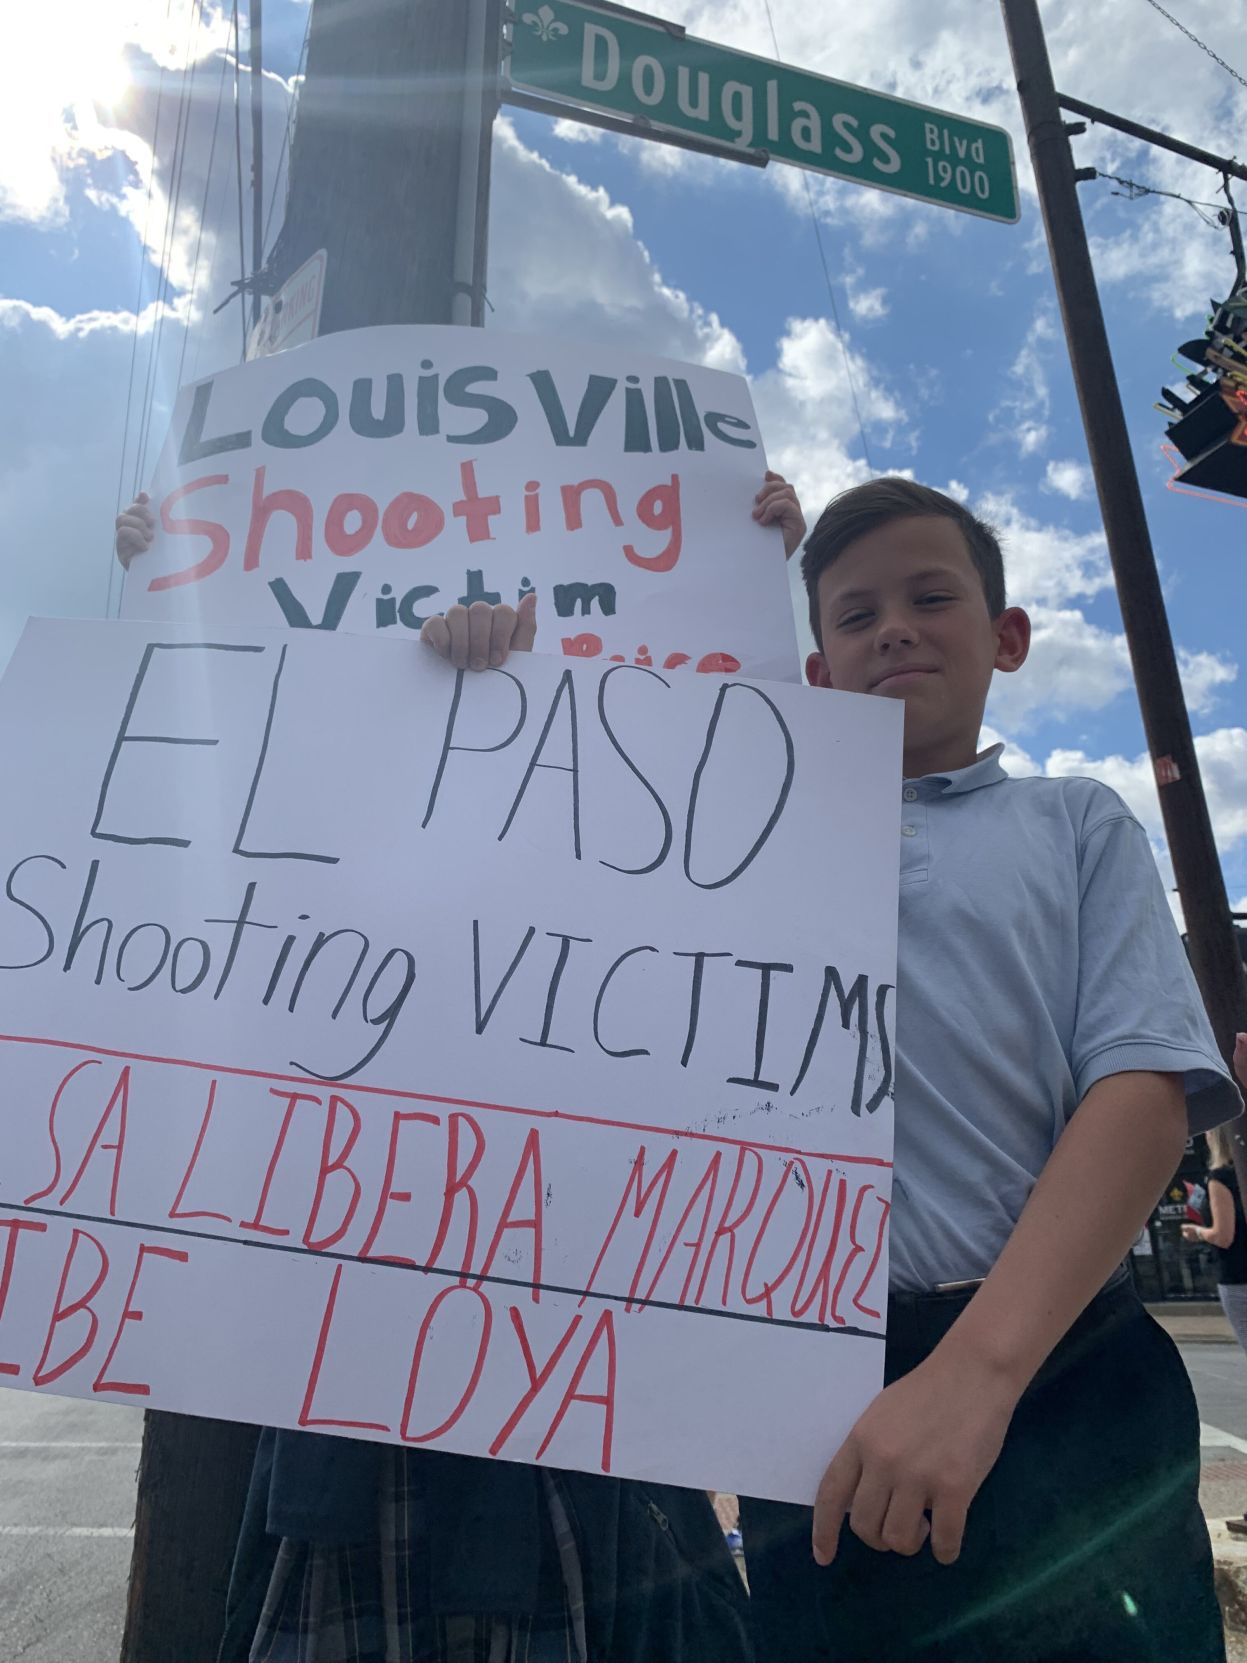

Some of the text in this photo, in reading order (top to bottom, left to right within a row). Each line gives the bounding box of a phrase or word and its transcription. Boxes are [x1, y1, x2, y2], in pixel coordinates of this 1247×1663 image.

[581, 21, 902, 174] Douglass
[924, 121, 985, 164] Blvd
[924, 156, 991, 199] 1900
[148, 459, 683, 592] Shooting
[268, 568, 617, 632] Victim
[90, 643, 795, 889] EL PASO
[0, 855, 896, 1117] Shooting VICTIMS
[168, 1079, 540, 1303] LIBERA
[578, 1145, 891, 1325] MARQUEZ
[298, 1264, 618, 1474] LOYA
